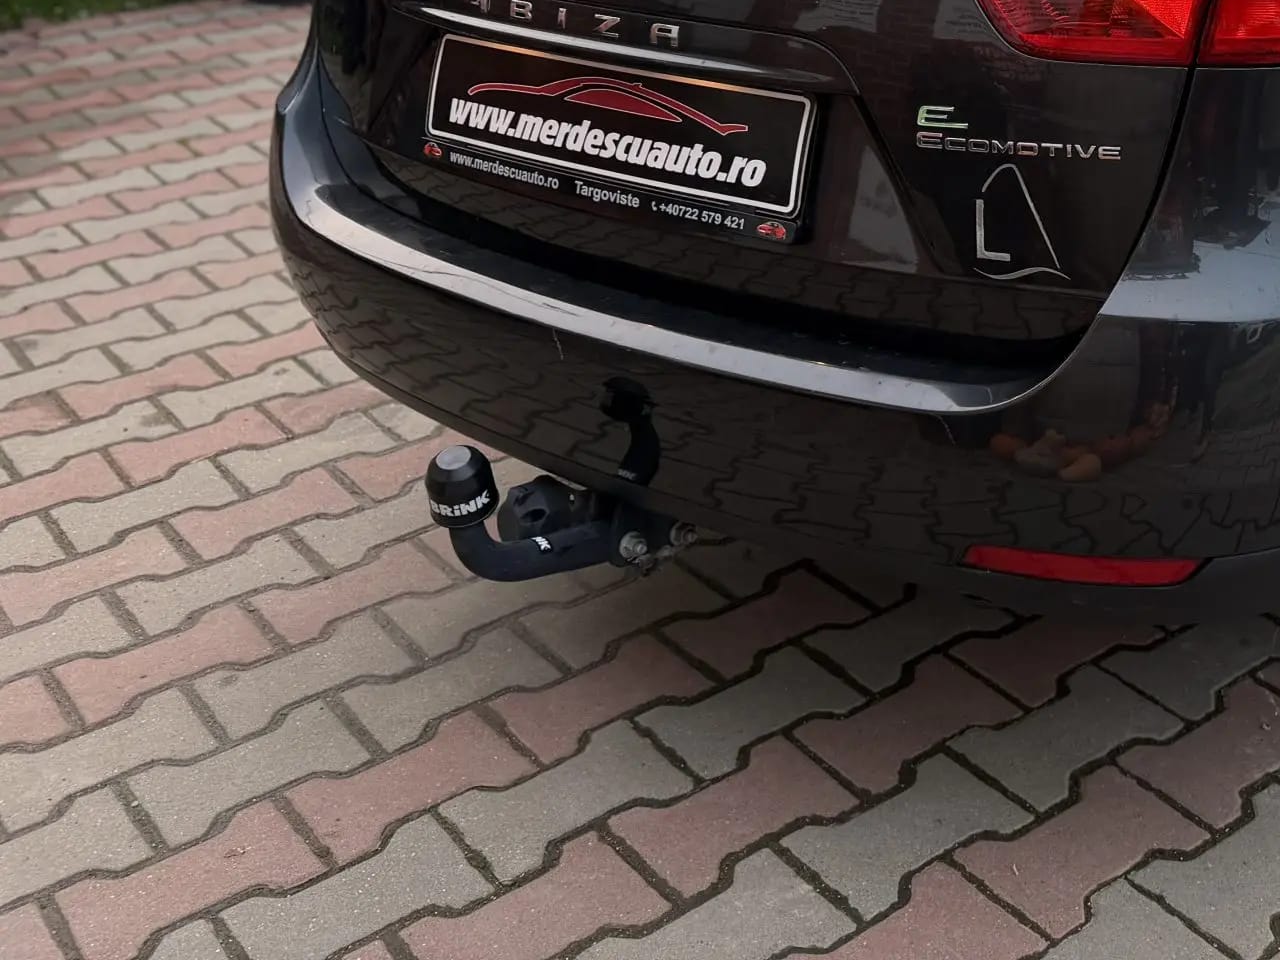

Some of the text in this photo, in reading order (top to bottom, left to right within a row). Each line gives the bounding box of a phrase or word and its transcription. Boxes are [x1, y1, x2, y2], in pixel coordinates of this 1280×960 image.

[449, 97, 767, 187] www.merdescuauto.ro
[915, 131, 1121, 161] ECOMOTIVE
[449, 151, 745, 230] www.merdescuauto.ro Targoviste +40722 579 421
